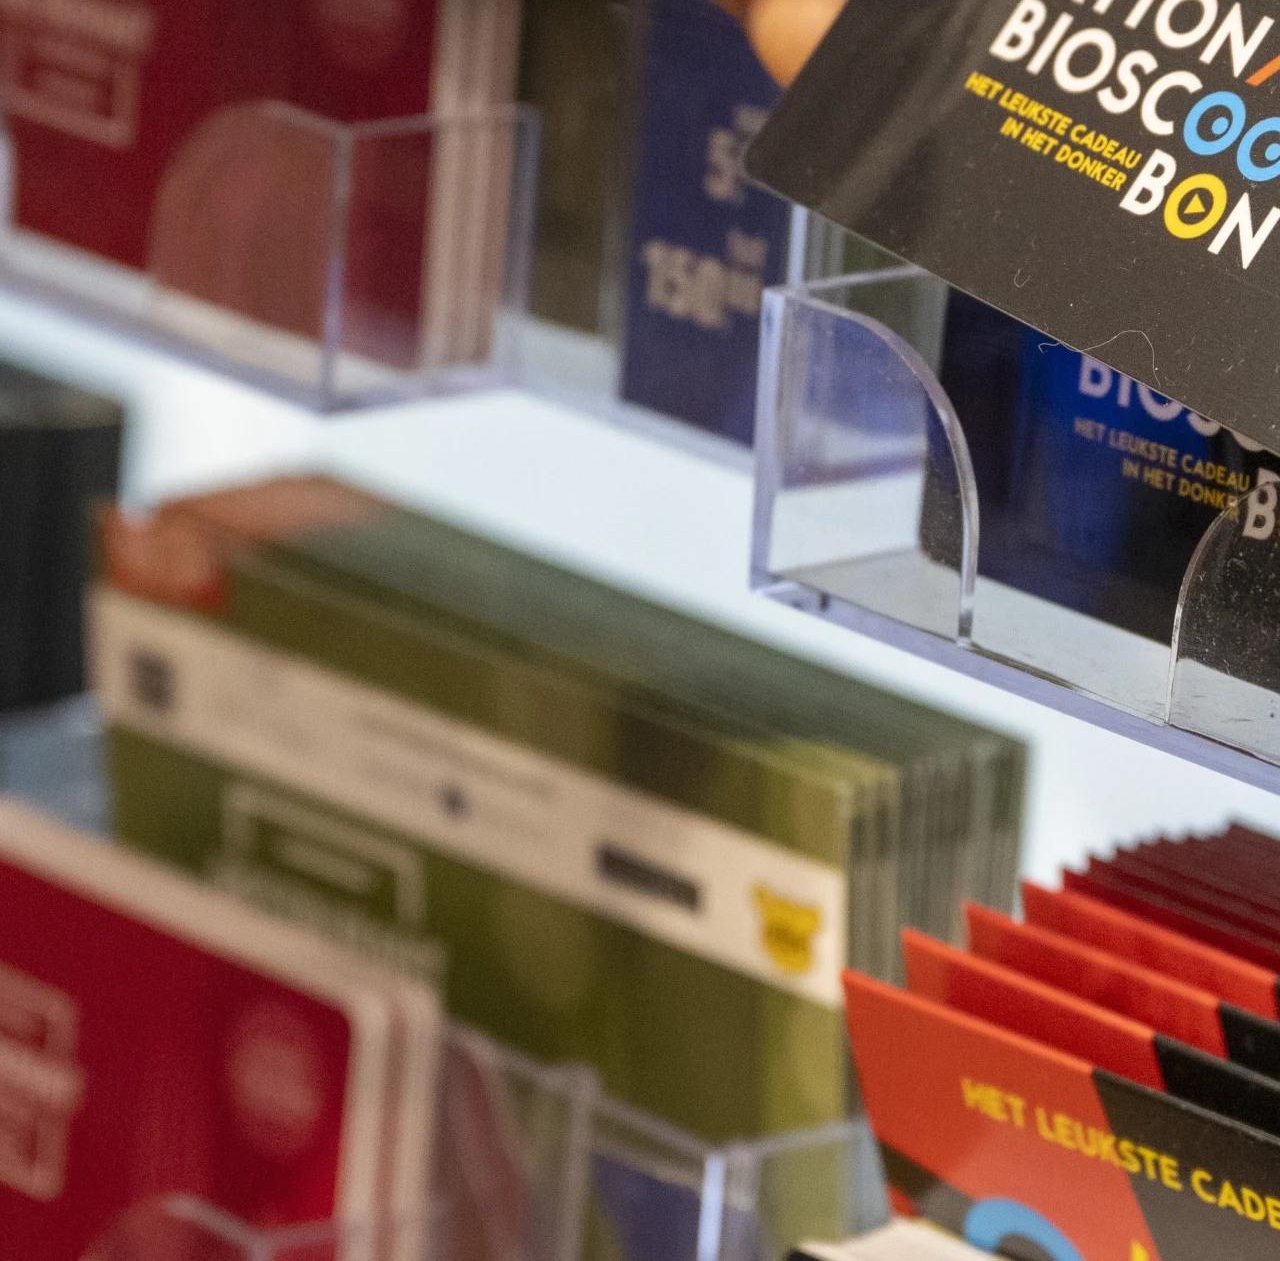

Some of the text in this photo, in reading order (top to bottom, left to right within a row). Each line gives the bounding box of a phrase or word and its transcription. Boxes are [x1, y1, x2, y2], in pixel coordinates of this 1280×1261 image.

[965, 71, 1142, 170] HET LEUKSTE CADEAU
[1000, 116, 1127, 191] IN HET DONKER
[1143, 466, 1176, 492] HET
[1182, 453, 1250, 493] CADEAU
[961, 1077, 1025, 1128] HET
[1035, 1107, 1183, 1191] LEUKSTE
